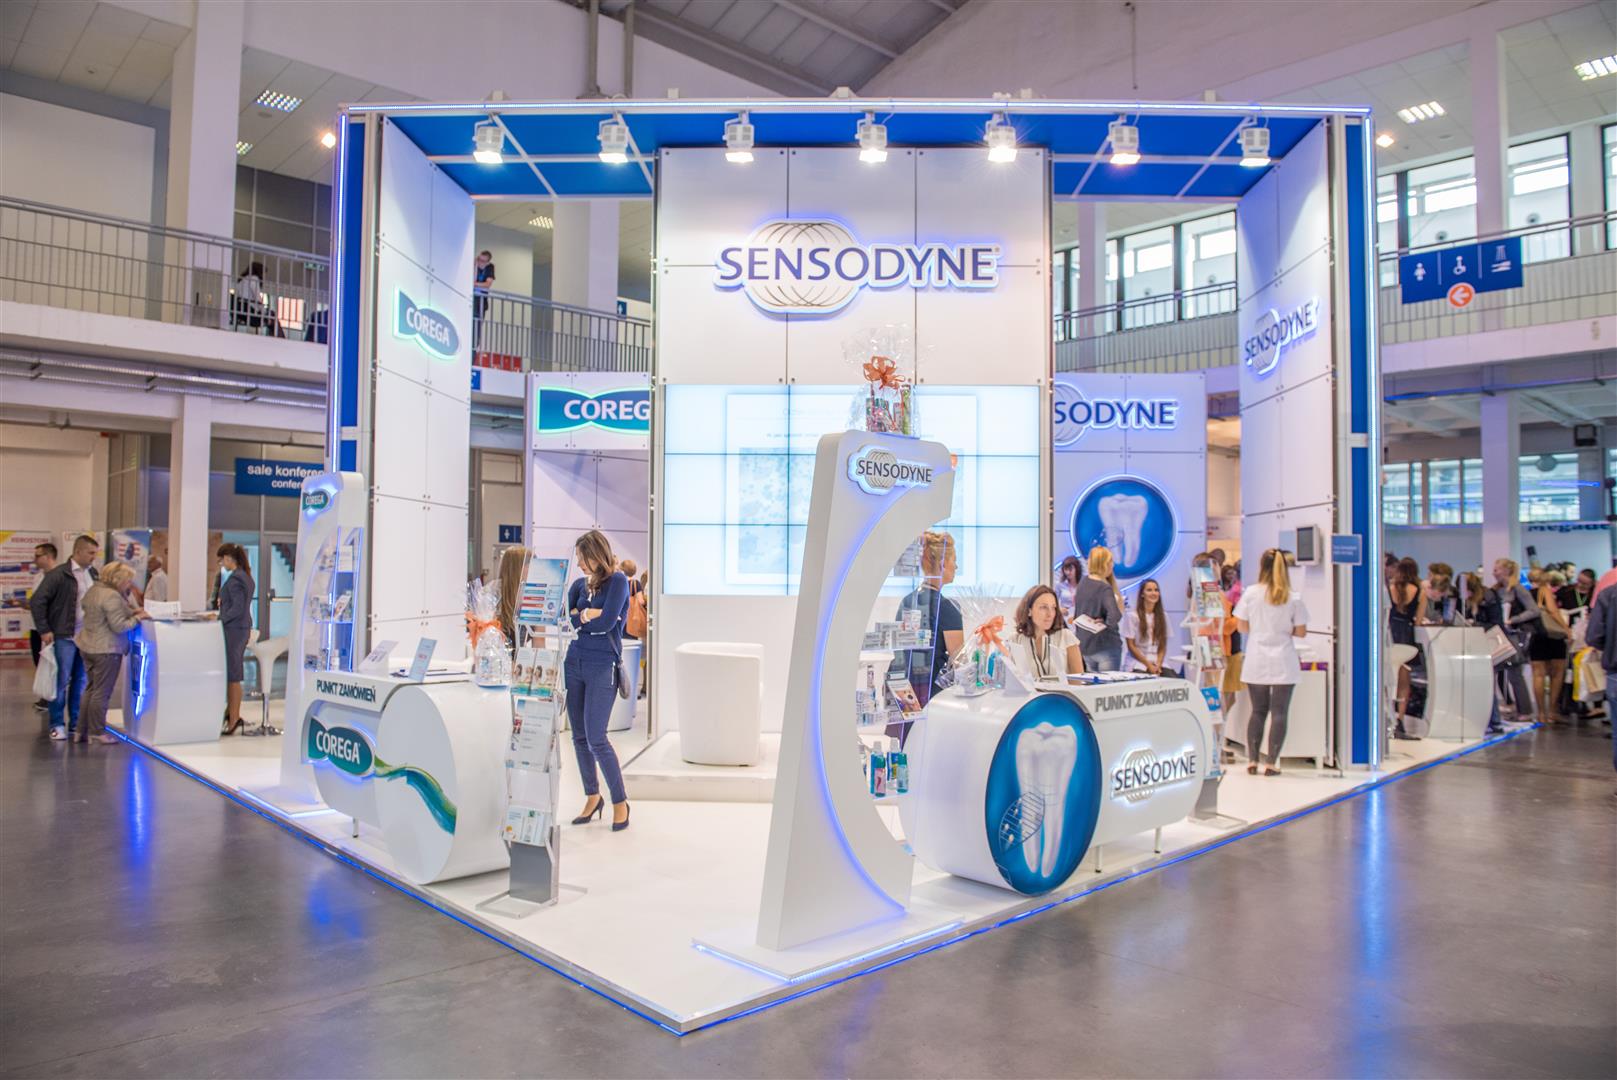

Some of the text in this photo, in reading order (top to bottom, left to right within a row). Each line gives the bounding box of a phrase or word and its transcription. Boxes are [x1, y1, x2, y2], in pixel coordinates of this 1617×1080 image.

[719, 247, 994, 281] SENSODYNE
[405, 306, 451, 348] COREGA
[1245, 302, 1314, 362] SENSODYNE
[563, 399, 650, 420] COREG
[1054, 401, 1175, 424] SODYNE
[247, 464, 272, 476] sale
[857, 459, 933, 483] SENSODYNE
[316, 679, 376, 703] PUNKT ZAMÓWIEŃ
[1095, 693, 1134, 713] PUNKT
[315, 730, 361, 765] COREGA
[1114, 755, 1197, 791] SENSODYNE
